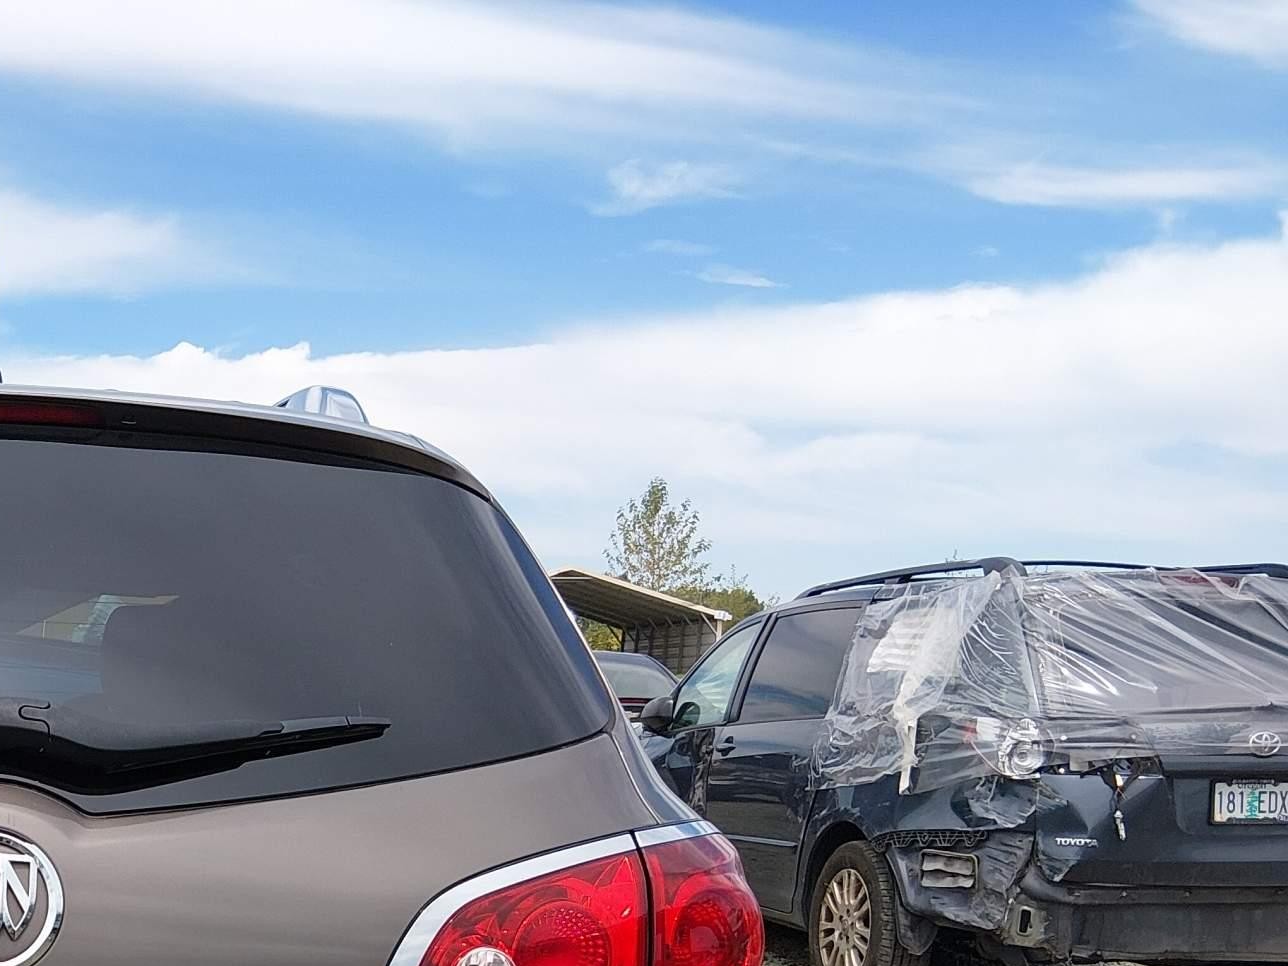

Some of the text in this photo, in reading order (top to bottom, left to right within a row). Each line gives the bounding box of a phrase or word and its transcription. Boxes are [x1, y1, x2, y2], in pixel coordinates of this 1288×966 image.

[1217, 790, 1288, 814] 181 EDX
[1055, 837, 1098, 848] TOYOTA
